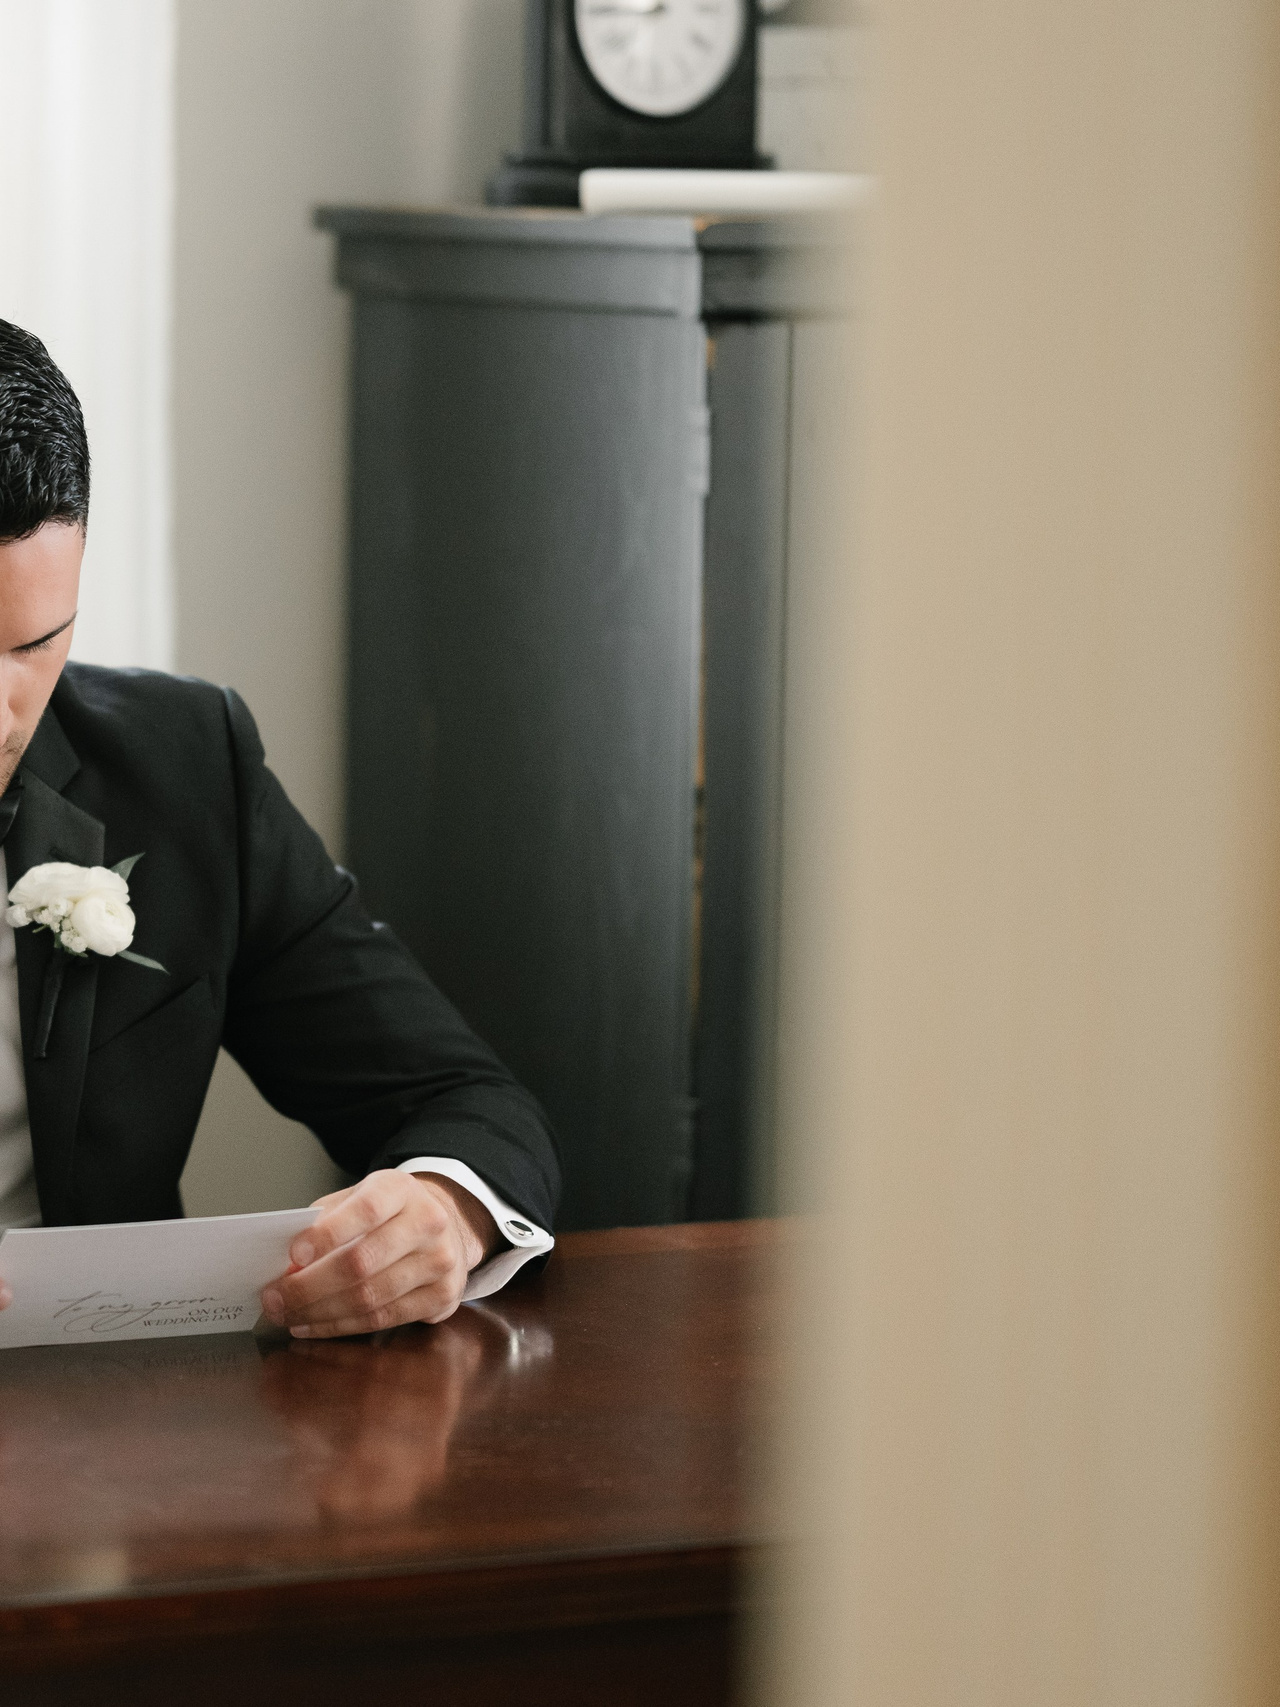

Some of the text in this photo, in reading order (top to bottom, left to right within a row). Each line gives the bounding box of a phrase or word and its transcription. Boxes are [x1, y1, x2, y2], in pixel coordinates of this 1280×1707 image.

[188, 1304, 244, 1316] ON OUR
[143, 1311, 241, 1327] WEDDING DAY
